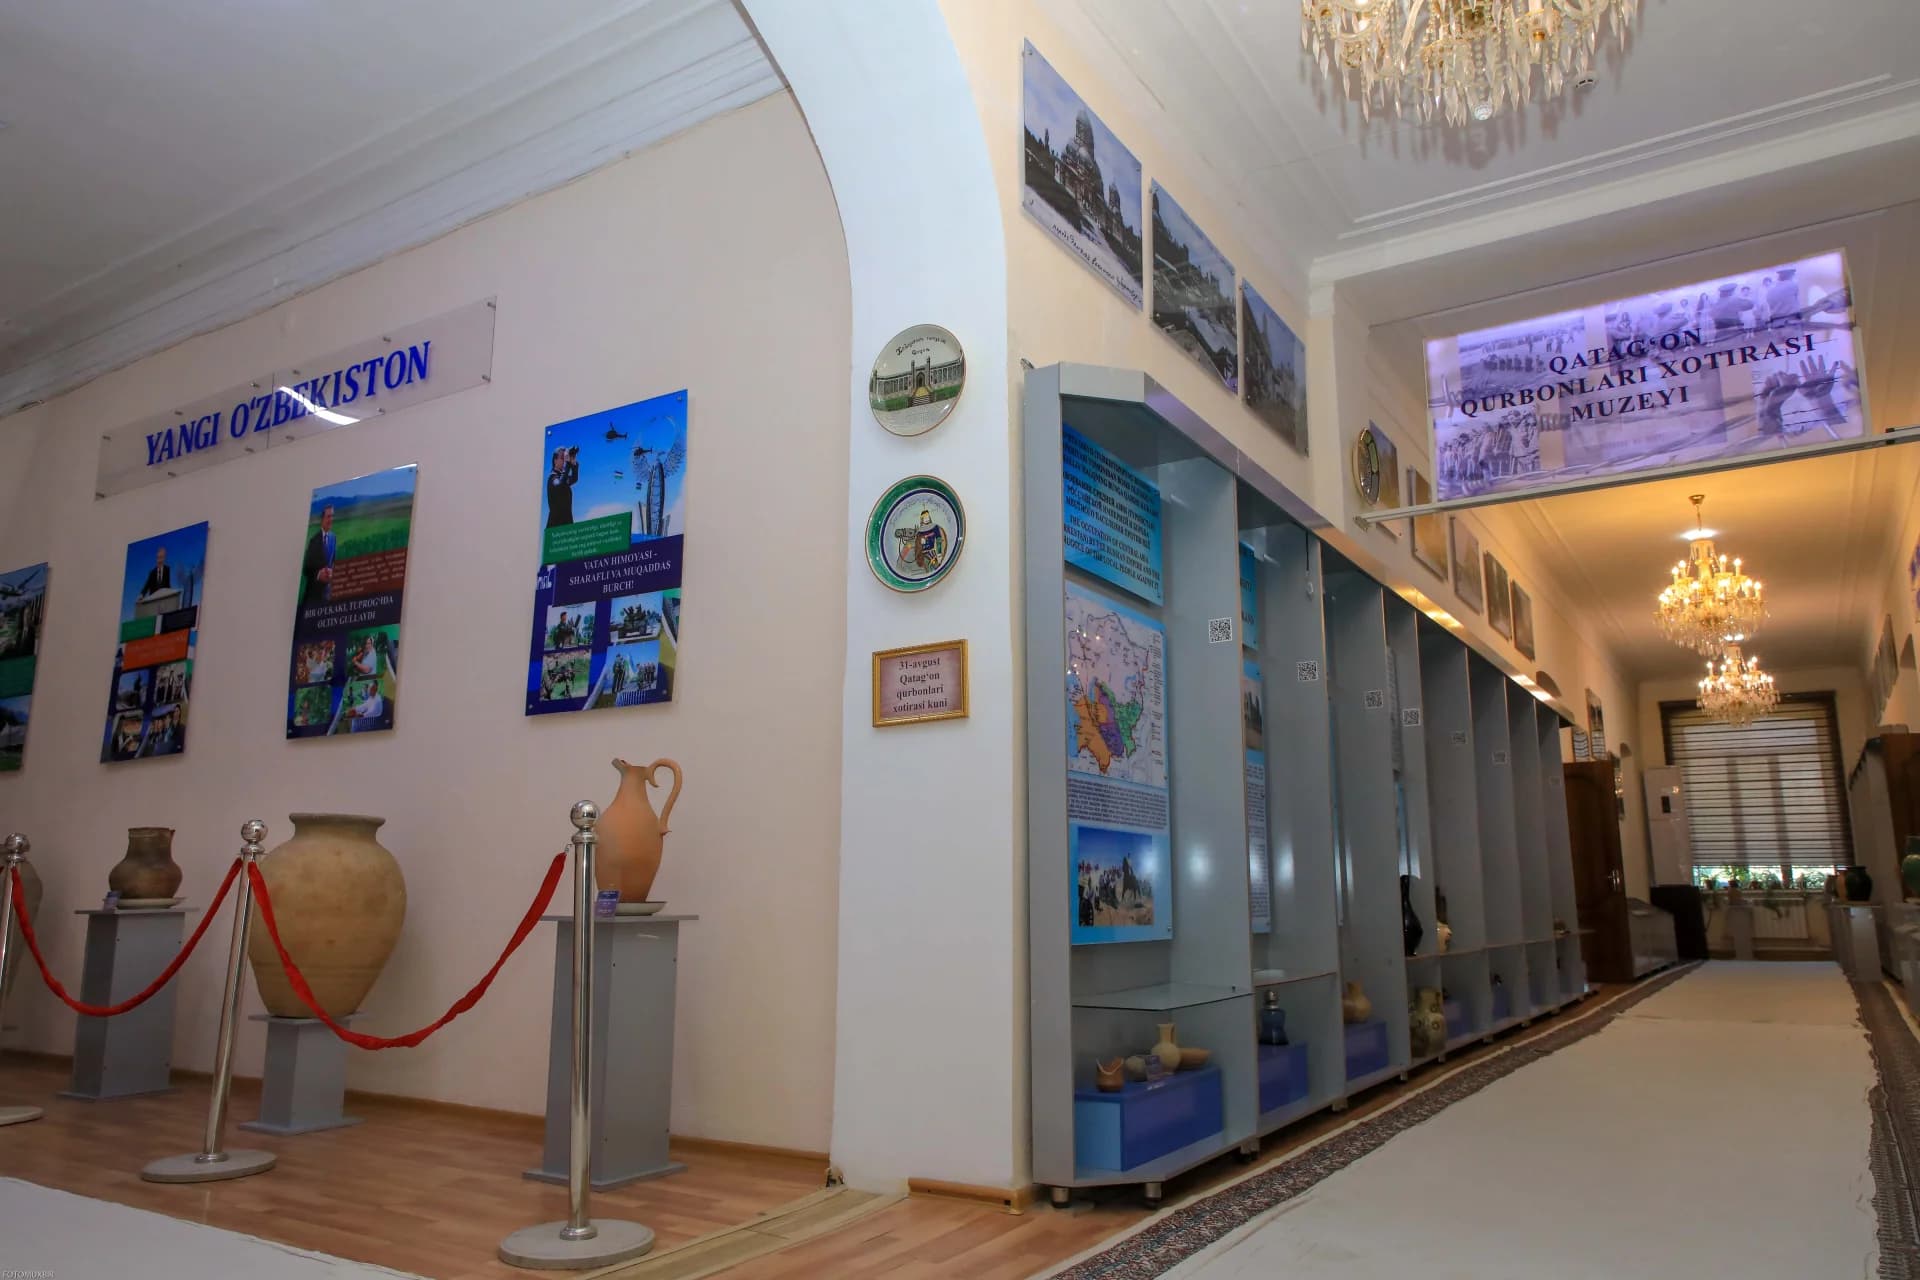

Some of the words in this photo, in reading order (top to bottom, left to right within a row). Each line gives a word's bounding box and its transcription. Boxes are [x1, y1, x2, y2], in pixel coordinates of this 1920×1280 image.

[1460, 368, 1648, 418] QURBONLARI
[1660, 334, 1817, 379] XOTIRASI
[1571, 385, 1690, 422] MUZEYI
[145, 411, 222, 466] YANGI
[583, 557, 611, 571] VATAN
[611, 549, 652, 566] HIMOYASI
[569, 571, 611, 586] SHARAFLI
[609, 570, 622, 581] VA
[623, 560, 672, 577] MUQADDAS
[602, 580, 635, 593] BURCH!
[899, 657, 940, 670] 31-avgust
[896, 684, 944, 700] qurbonlari
[893, 700, 925, 713] xotirasi
[927, 698, 948, 709] kuni
